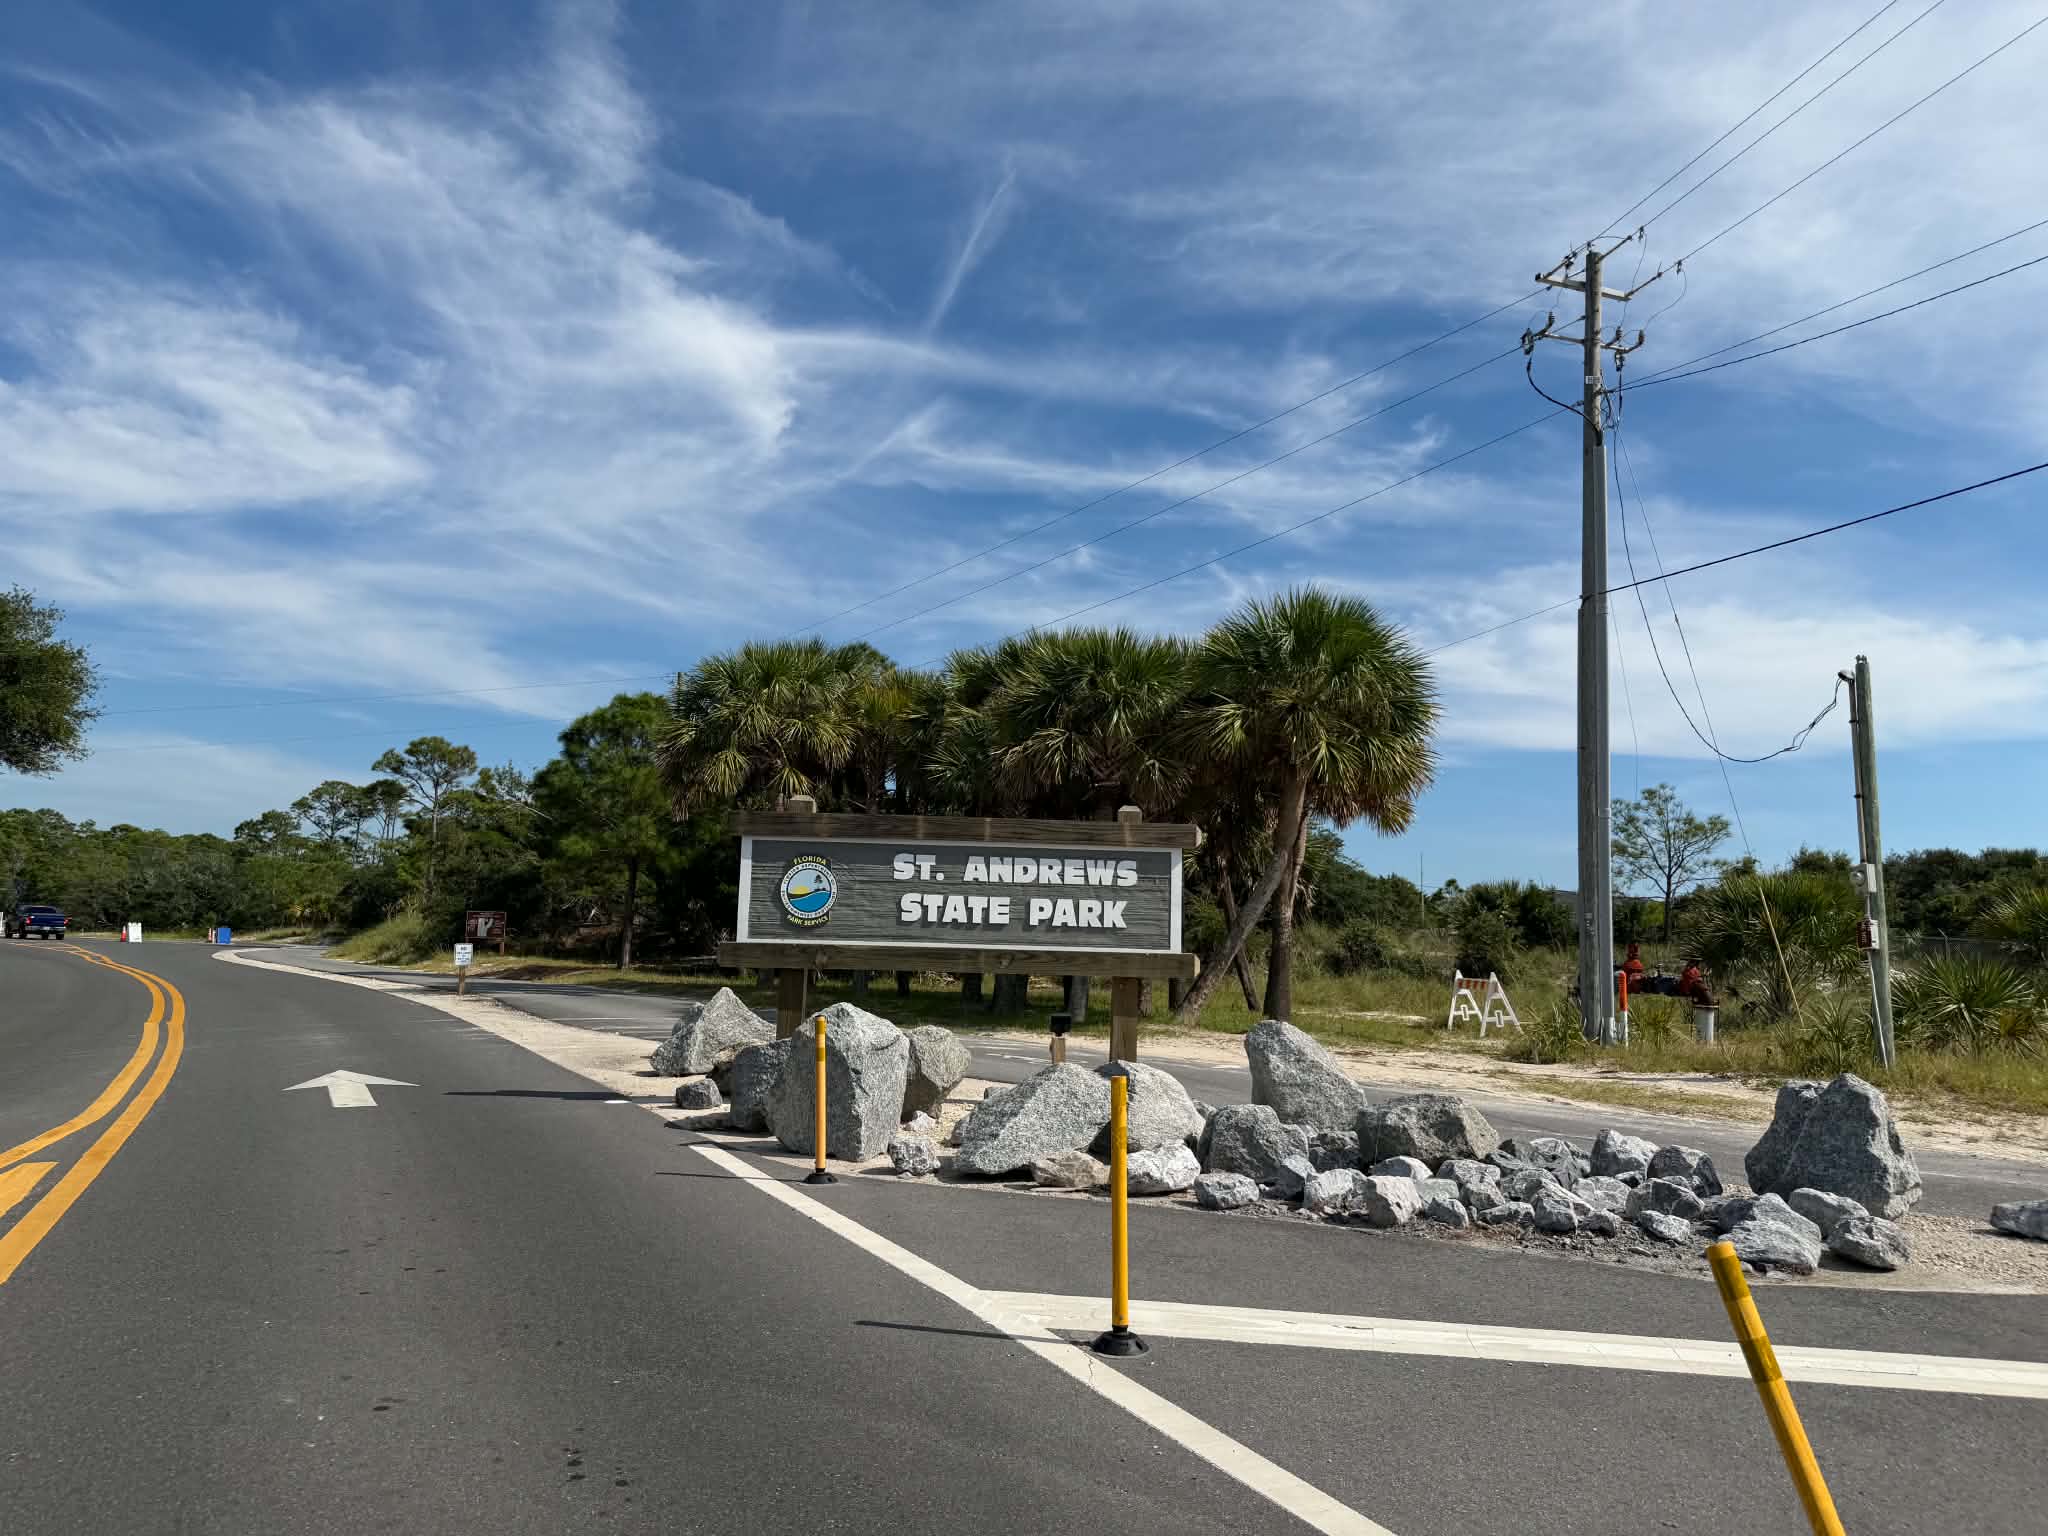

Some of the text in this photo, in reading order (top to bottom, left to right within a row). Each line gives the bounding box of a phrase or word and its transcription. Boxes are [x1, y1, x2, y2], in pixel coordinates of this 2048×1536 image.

[793, 856, 827, 865] FLORIDA
[893, 853, 1138, 887] ST. ANDREWS
[787, 914, 829, 926] PARK SERVICE
[900, 893, 1128, 929] STATE PARK
